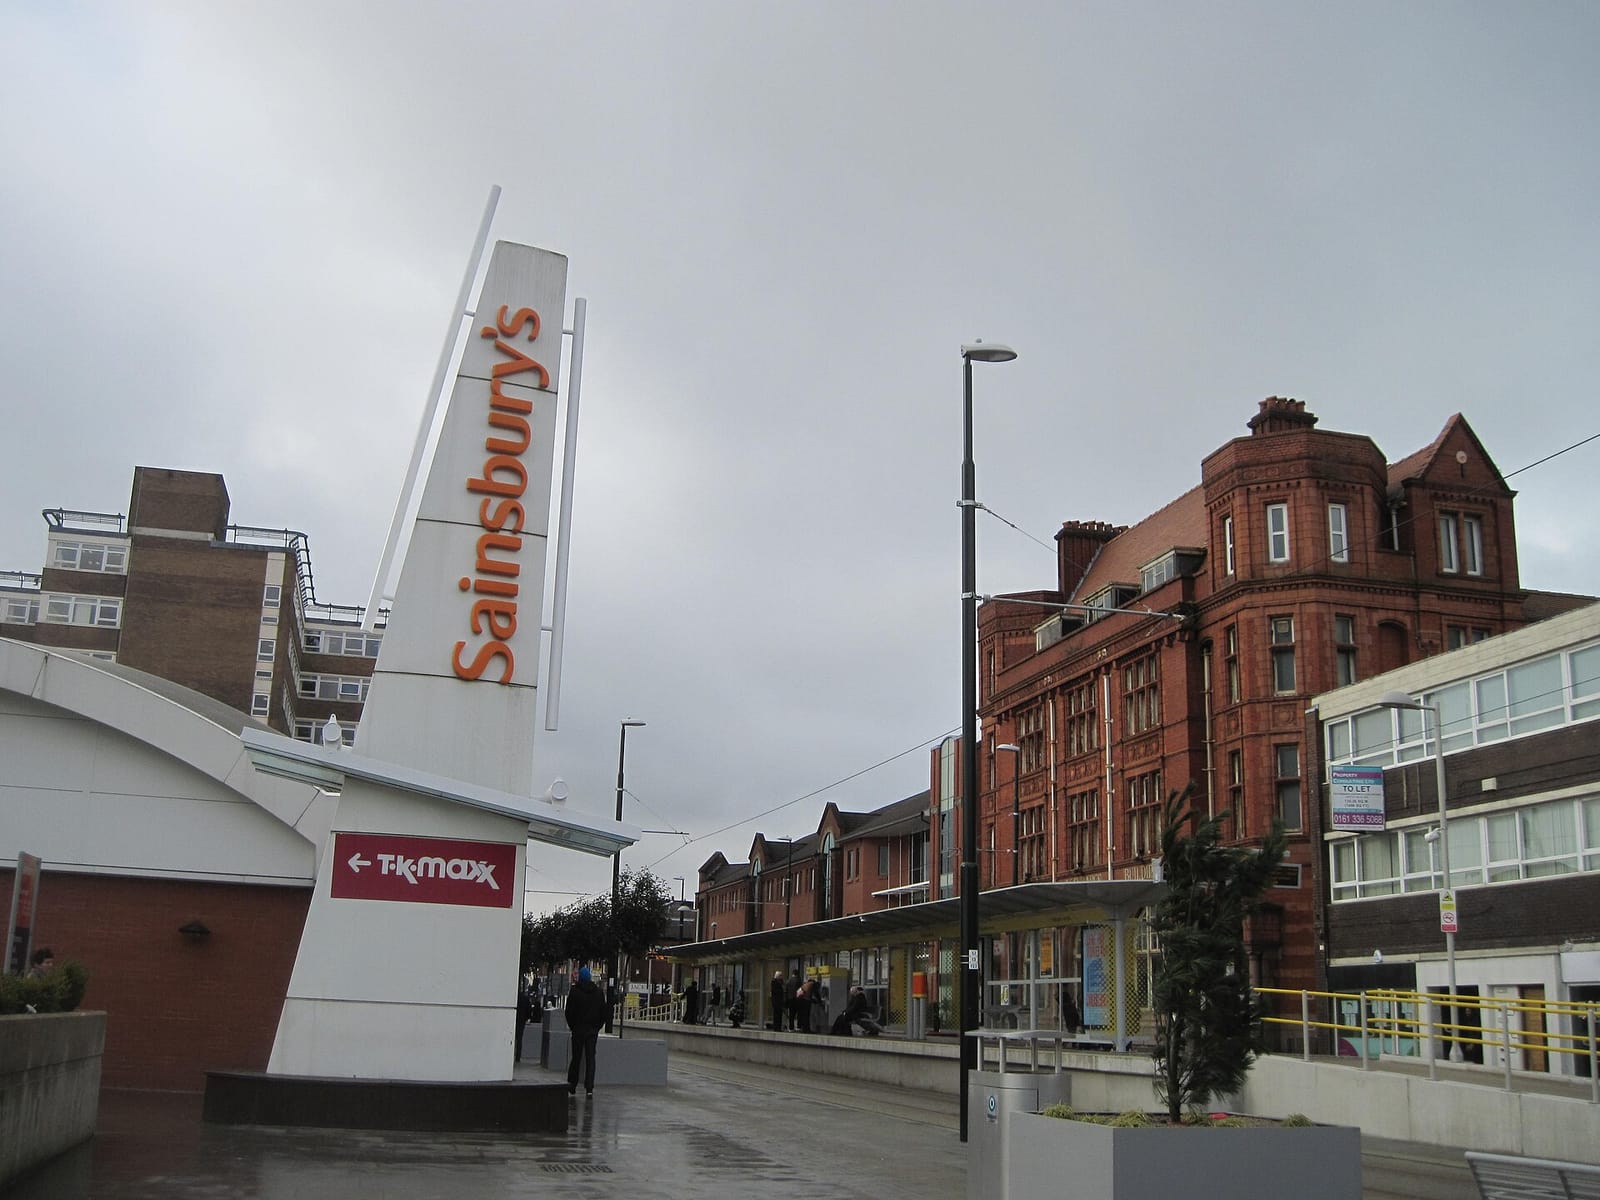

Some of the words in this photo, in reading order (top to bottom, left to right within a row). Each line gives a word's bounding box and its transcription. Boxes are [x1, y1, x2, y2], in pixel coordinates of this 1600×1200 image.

[452, 304, 550, 684] Sainsbury's
[1343, 785, 1354, 793] TO
[1356, 785, 1371, 793] LET
[1334, 814, 1350, 824] 0161
